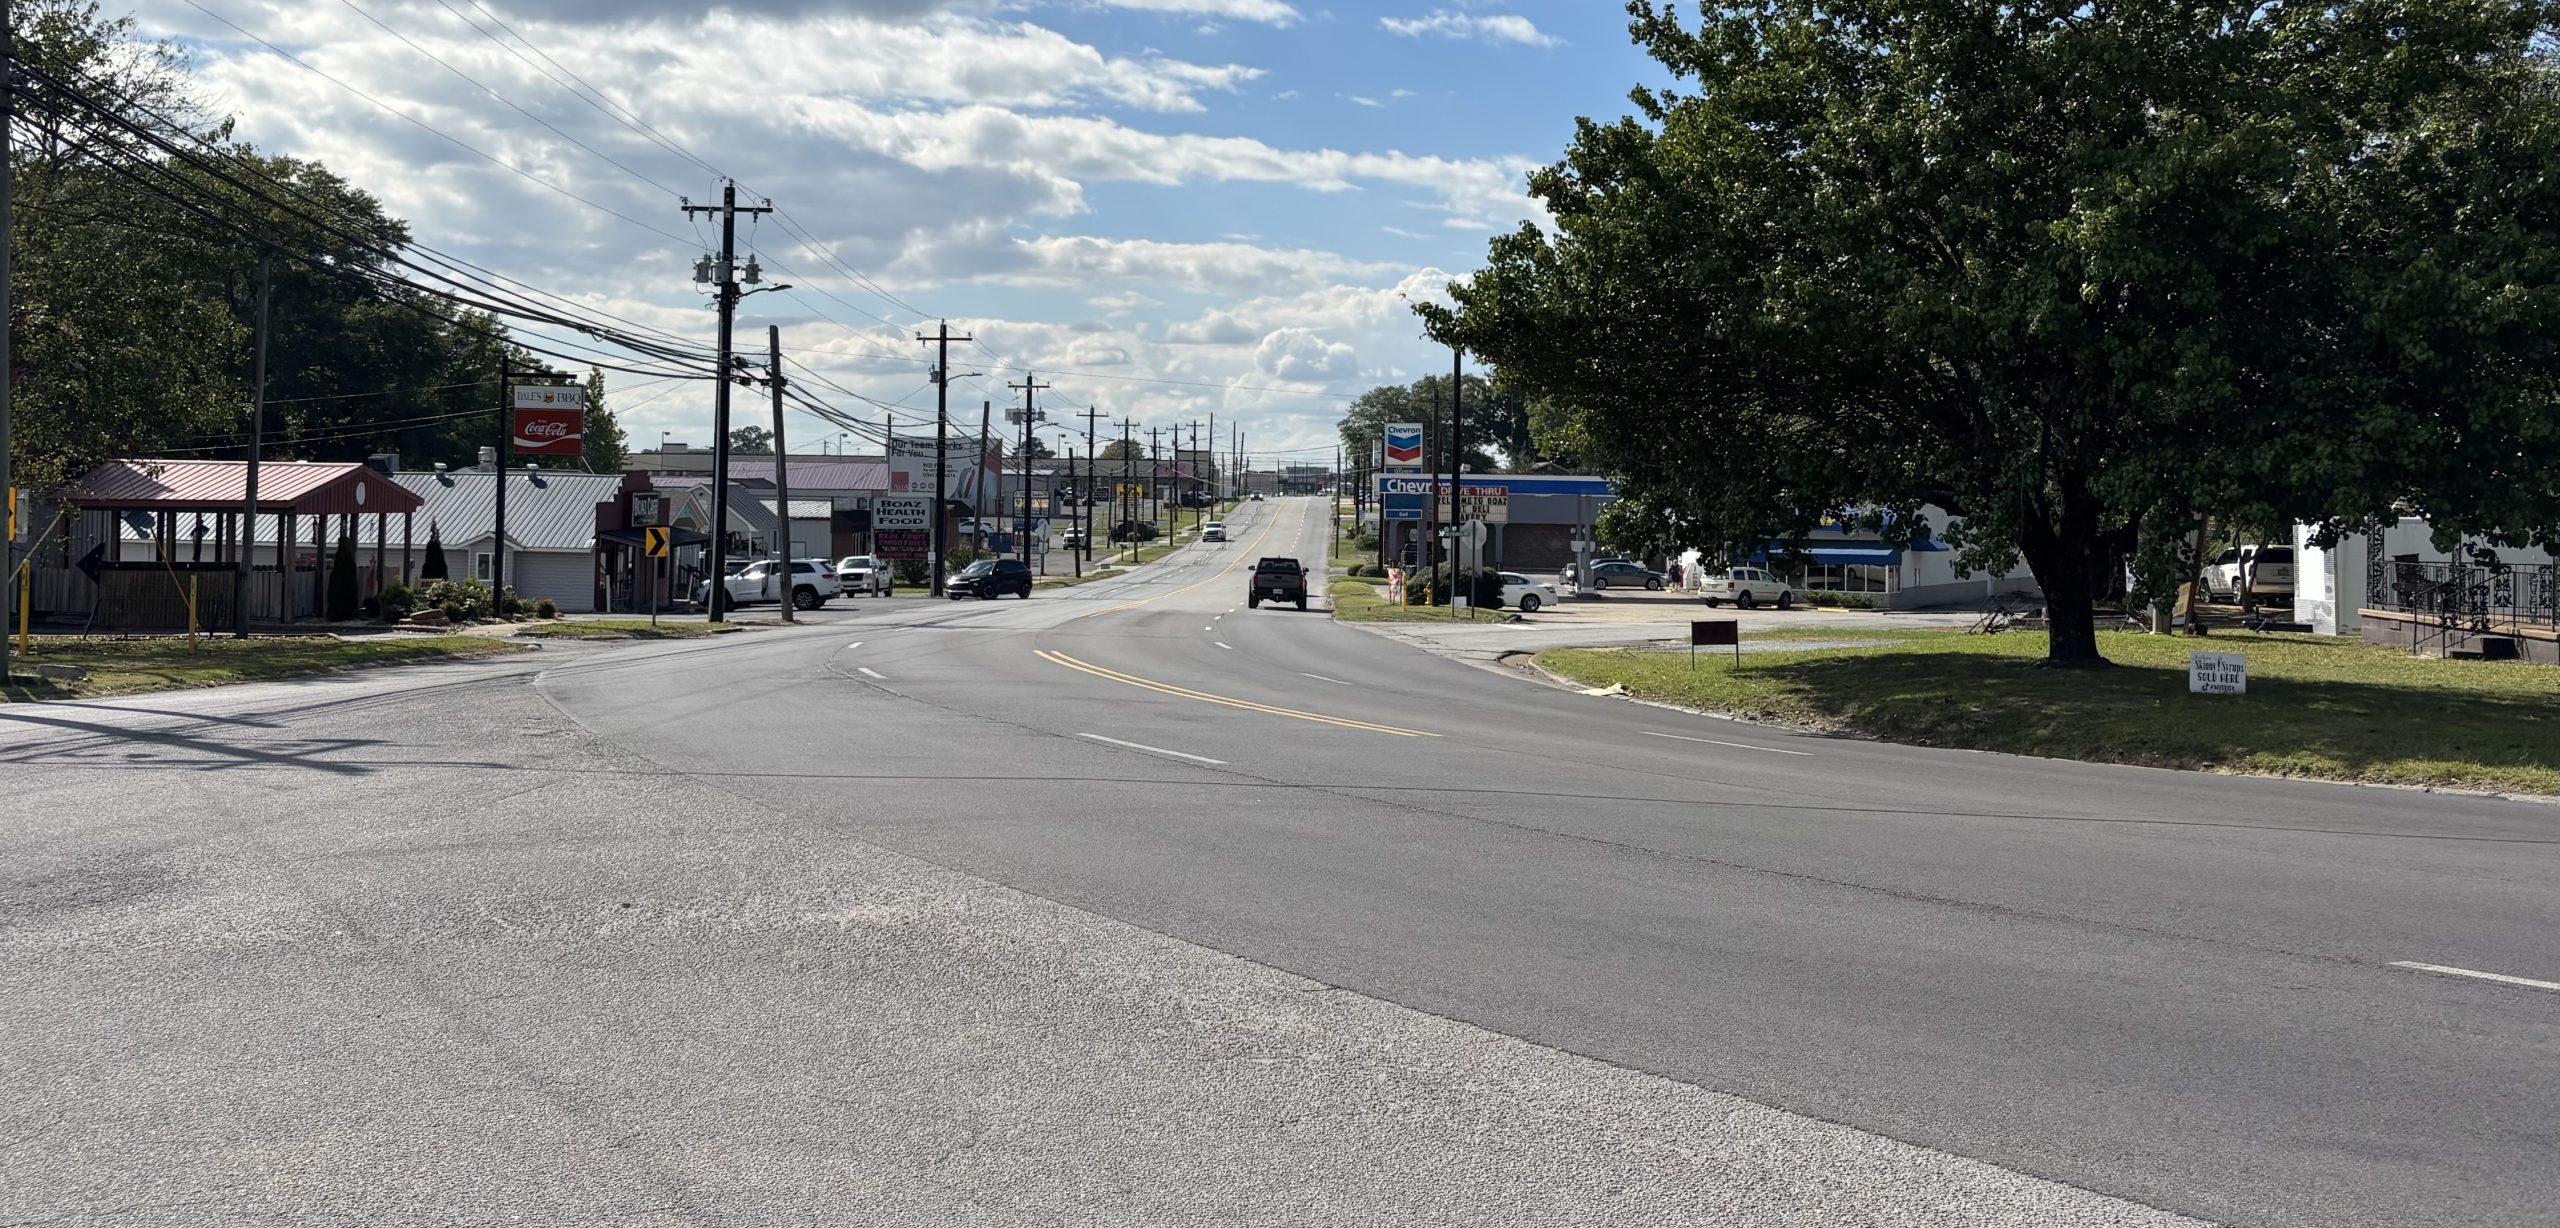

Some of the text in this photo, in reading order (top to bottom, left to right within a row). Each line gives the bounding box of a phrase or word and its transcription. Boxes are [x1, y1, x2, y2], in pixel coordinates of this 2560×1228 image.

[557, 392, 581, 405] BBQ
[524, 421, 568, 436] Coca-Cola
[1388, 426, 1421, 434] Chevron
[891, 439, 963, 450] Our Team orks
[891, 449, 924, 458] For You
[1386, 479, 1452, 493] Chevr
[1441, 487, 1502, 495] DRE THRU
[880, 500, 922, 508] BOAZ
[876, 508, 926, 516] HEALTH
[1472, 505, 1490, 513] DELI
[879, 517, 924, 525] FOOD
[1459, 513, 1487, 521] AKERY
[2197, 672, 2241, 684] SOLD HERE
